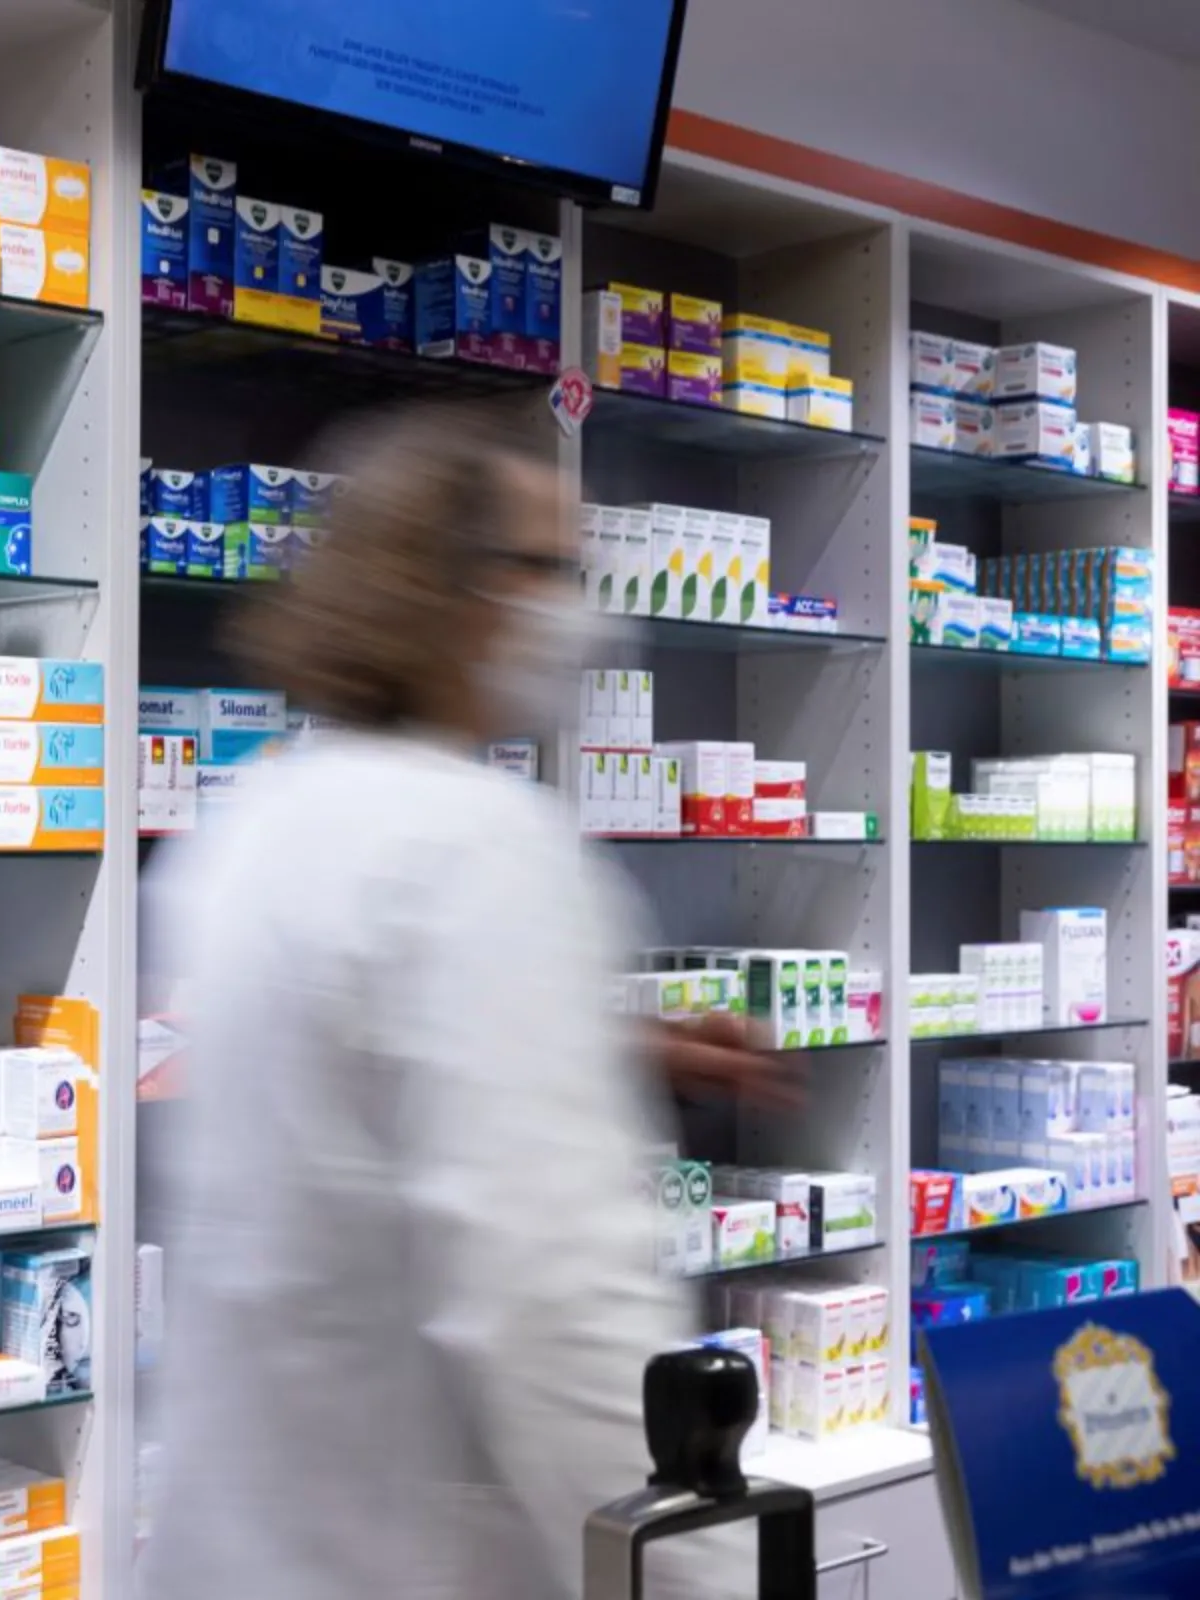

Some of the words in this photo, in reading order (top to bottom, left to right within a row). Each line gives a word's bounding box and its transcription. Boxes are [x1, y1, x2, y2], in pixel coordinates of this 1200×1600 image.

[4, 671, 32, 687] forte
[218, 698, 268, 717] Silomat
[3, 736, 31, 751] forte
[3, 799, 31, 815] forte
